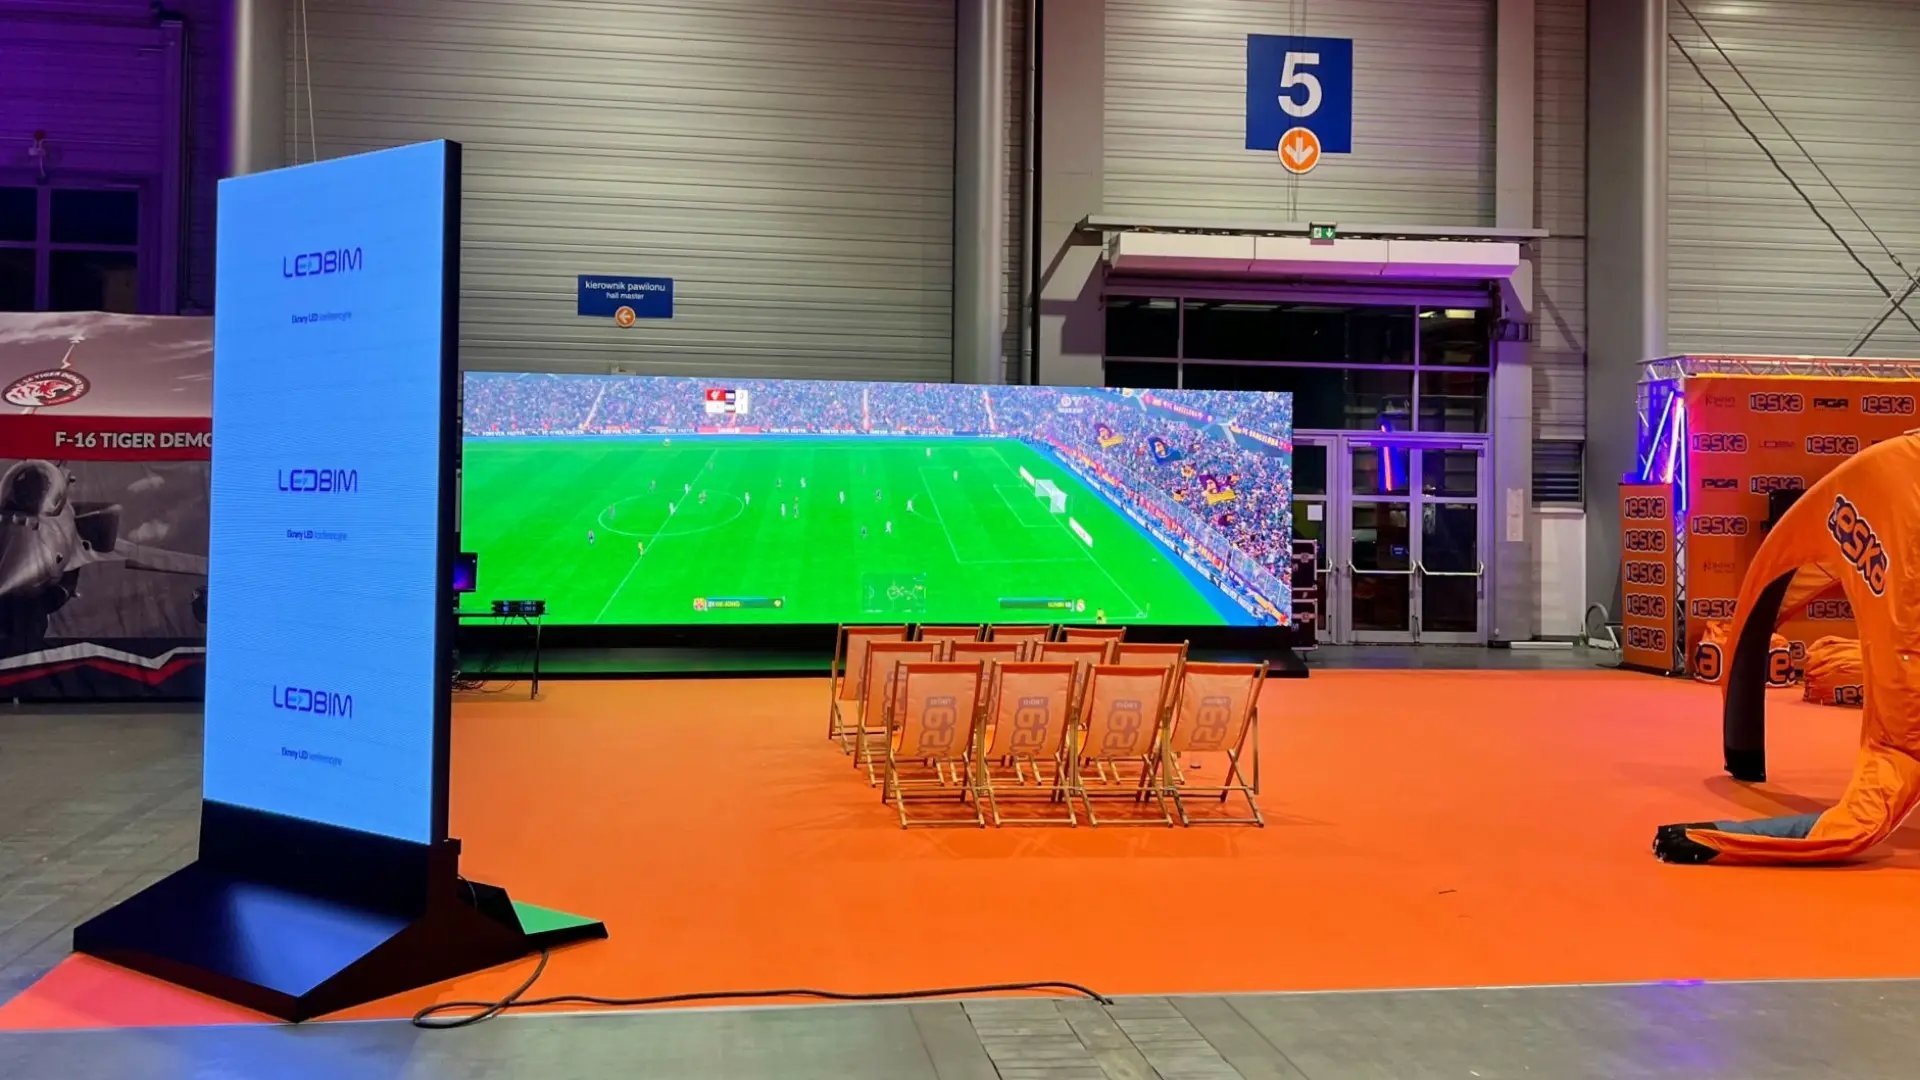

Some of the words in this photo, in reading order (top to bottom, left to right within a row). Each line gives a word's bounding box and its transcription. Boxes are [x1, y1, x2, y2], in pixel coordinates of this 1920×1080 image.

[1278, 51, 1322, 117] 5
[283, 247, 362, 278] LEDBIM
[585, 280, 625, 290] kierownik
[627, 282, 666, 292] pawilonu
[620, 292, 644, 300] master
[55, 431, 96, 447] F-16
[100, 432, 155, 448] TIGER
[278, 469, 358, 493] LEDBIM
[273, 684, 352, 719] LEDBIM
